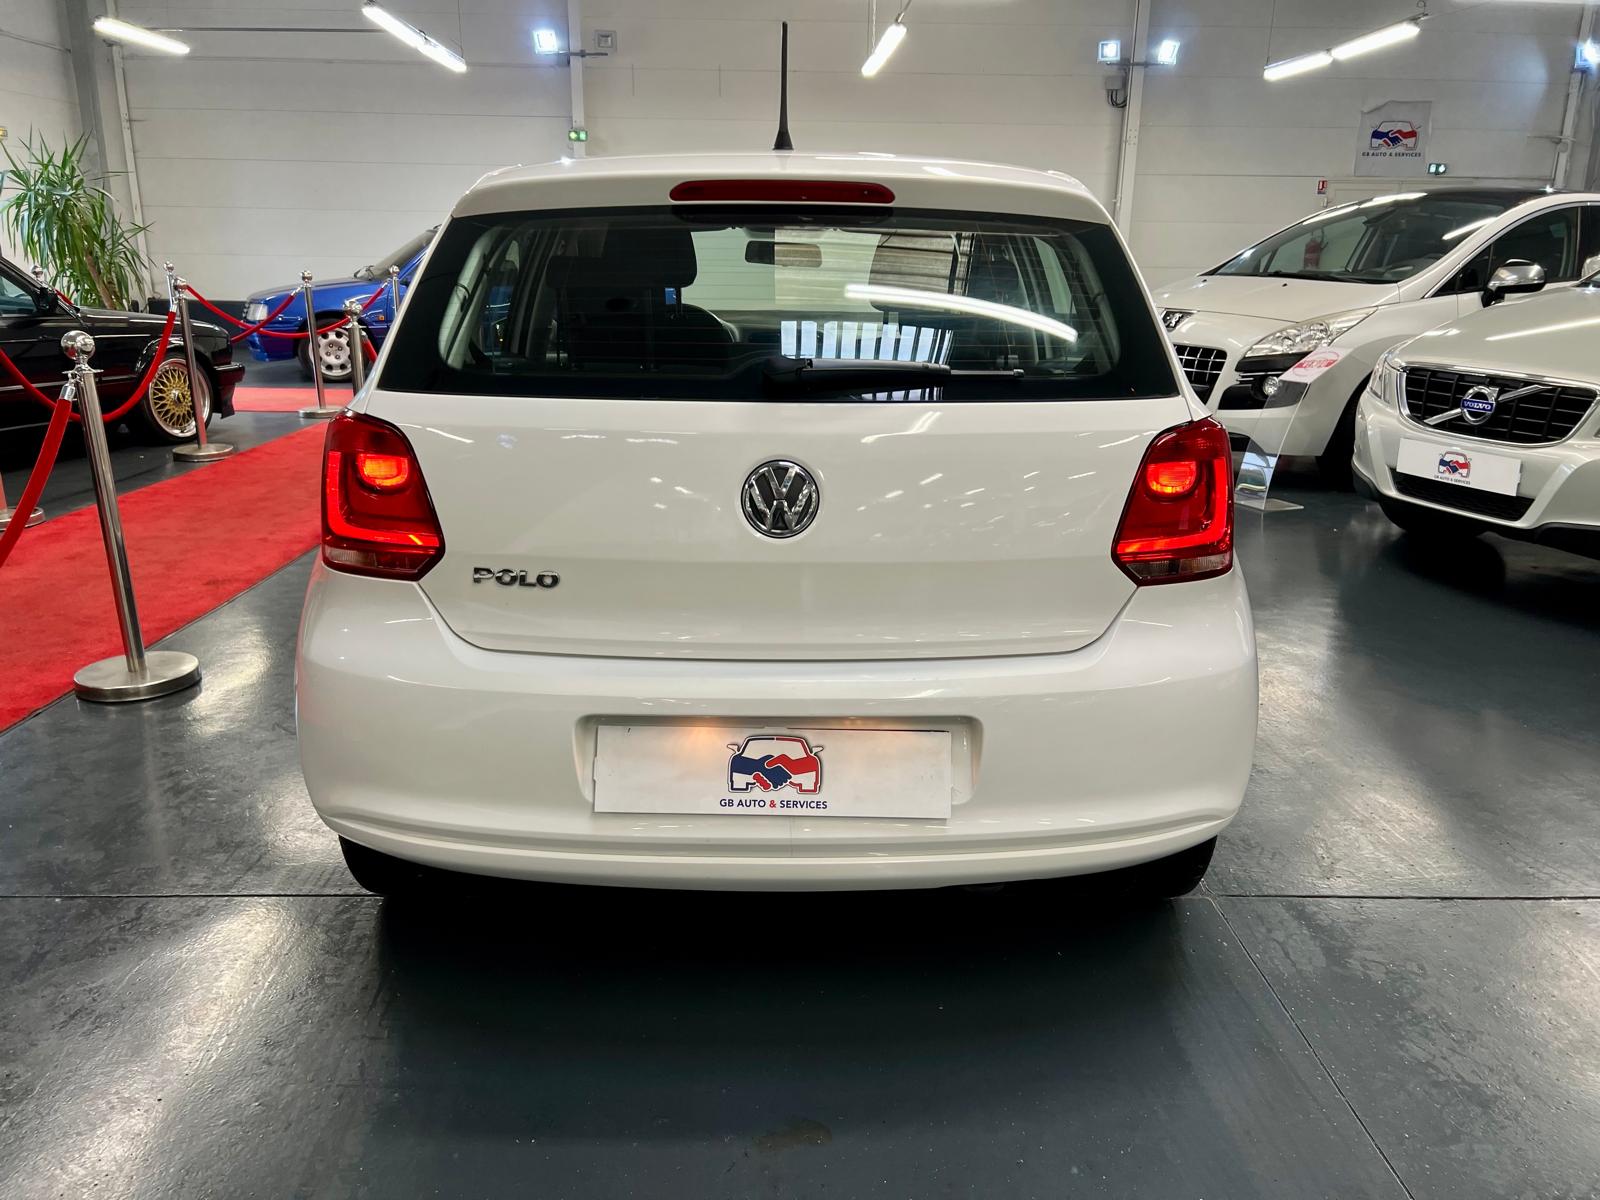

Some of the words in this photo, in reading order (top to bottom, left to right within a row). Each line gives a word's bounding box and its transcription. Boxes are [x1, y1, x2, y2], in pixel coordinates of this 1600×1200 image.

[1463, 400, 1492, 410] VOLVO
[473, 567, 560, 588] POLO
[719, 799, 734, 808] GB
[737, 799, 766, 808] AUTO
[768, 799, 777, 808] &
[779, 800, 828, 809] SERVICES
